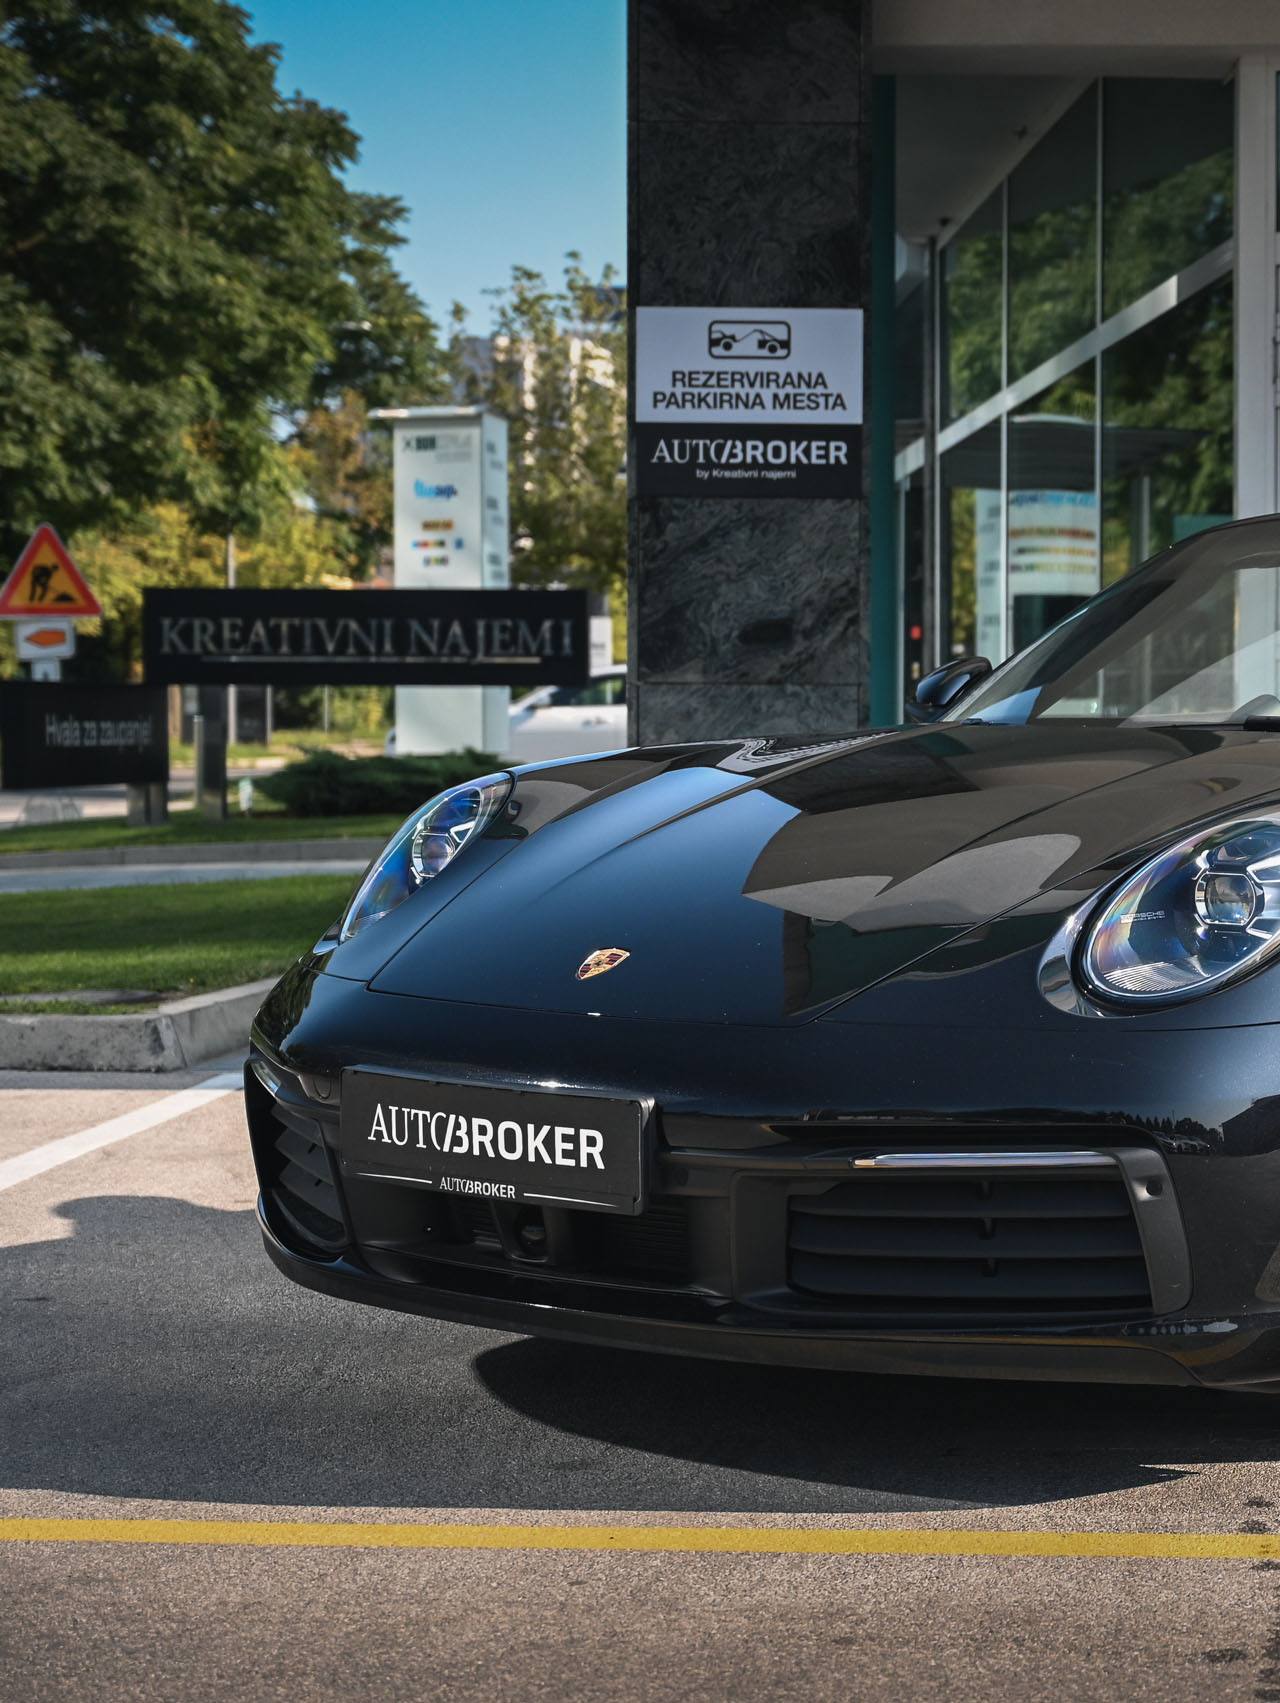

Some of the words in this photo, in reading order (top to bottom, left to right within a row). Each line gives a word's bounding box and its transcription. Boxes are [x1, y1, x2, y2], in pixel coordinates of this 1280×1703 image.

[672, 370, 828, 389] REZERVIRANA
[652, 391, 766, 410] PARKIRNA
[772, 392, 847, 411] MESTA
[696, 468, 710, 480] by
[712, 468, 759, 479] Kreativni
[761, 468, 797, 480] najemi
[160, 616, 395, 655] KREATIVNI
[408, 616, 574, 664] NAJEMI
[45, 713, 80, 747] Hvala
[83, 720, 97, 747] za
